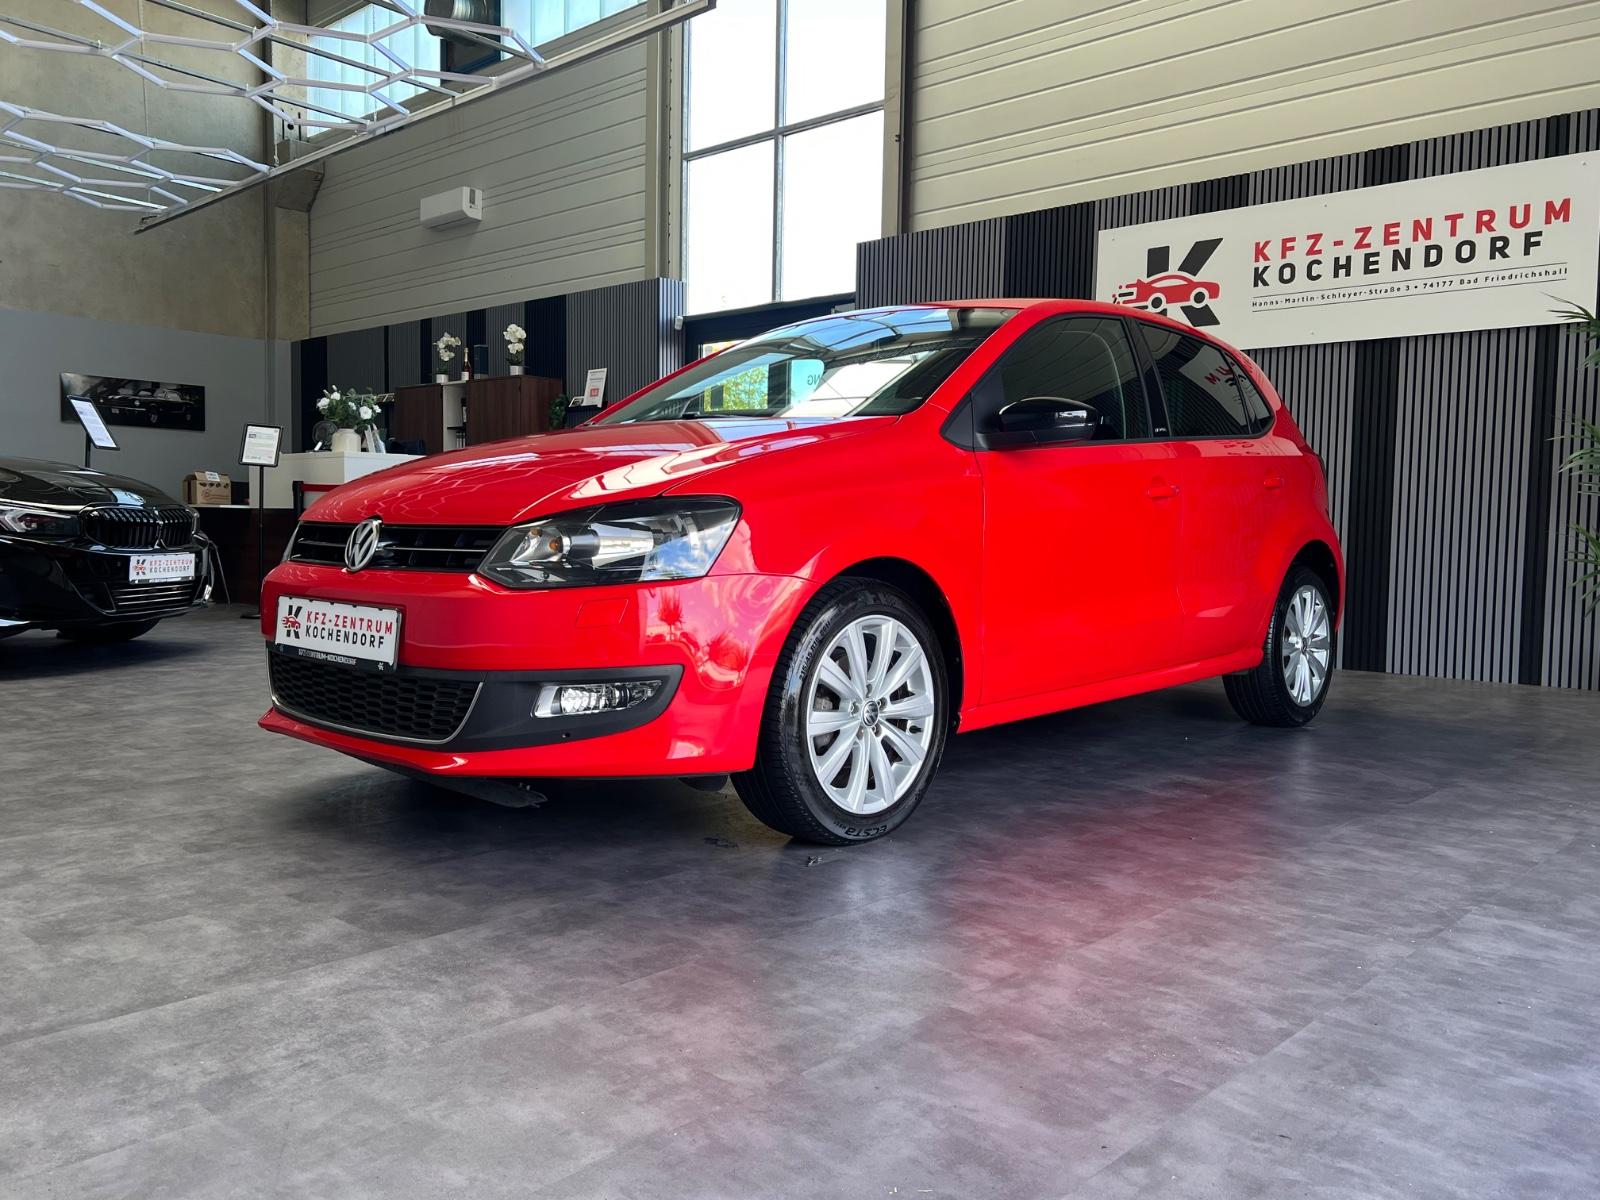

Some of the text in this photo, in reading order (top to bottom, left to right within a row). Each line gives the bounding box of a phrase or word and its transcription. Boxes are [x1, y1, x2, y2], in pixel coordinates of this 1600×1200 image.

[1253, 197, 1571, 264] KFZ-ZENTRUM
[1252, 230, 1543, 288] KOCHENDORF
[1251, 267, 1568, 308] Hanns-Martin-Schleyer-Straße 3 74177 Bad Friedrichshall
[305, 625, 385, 649] KOCHENDORF
[306, 610, 393, 635] KFZ-ZENTRUM
